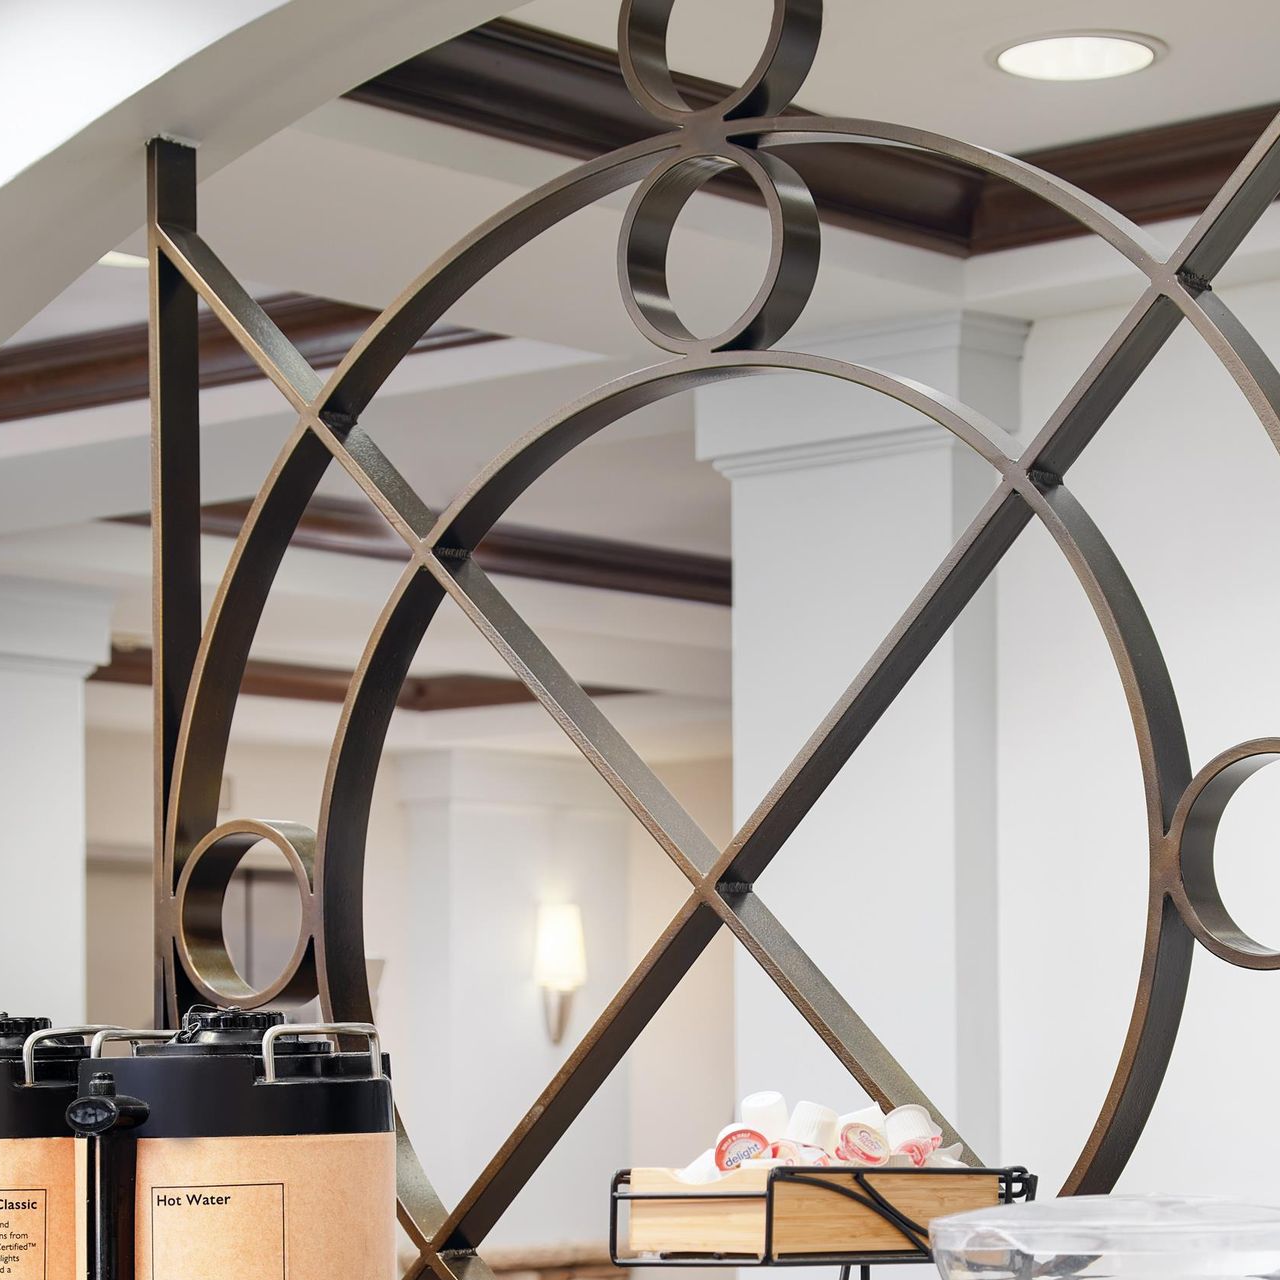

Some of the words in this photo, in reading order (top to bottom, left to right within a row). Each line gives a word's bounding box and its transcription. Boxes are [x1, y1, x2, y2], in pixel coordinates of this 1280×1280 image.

[726, 1144, 760, 1167] delight
[156, 1195, 182, 1207] Hot
[186, 1194, 231, 1206] Water
[9, 1231, 29, 1240] from
